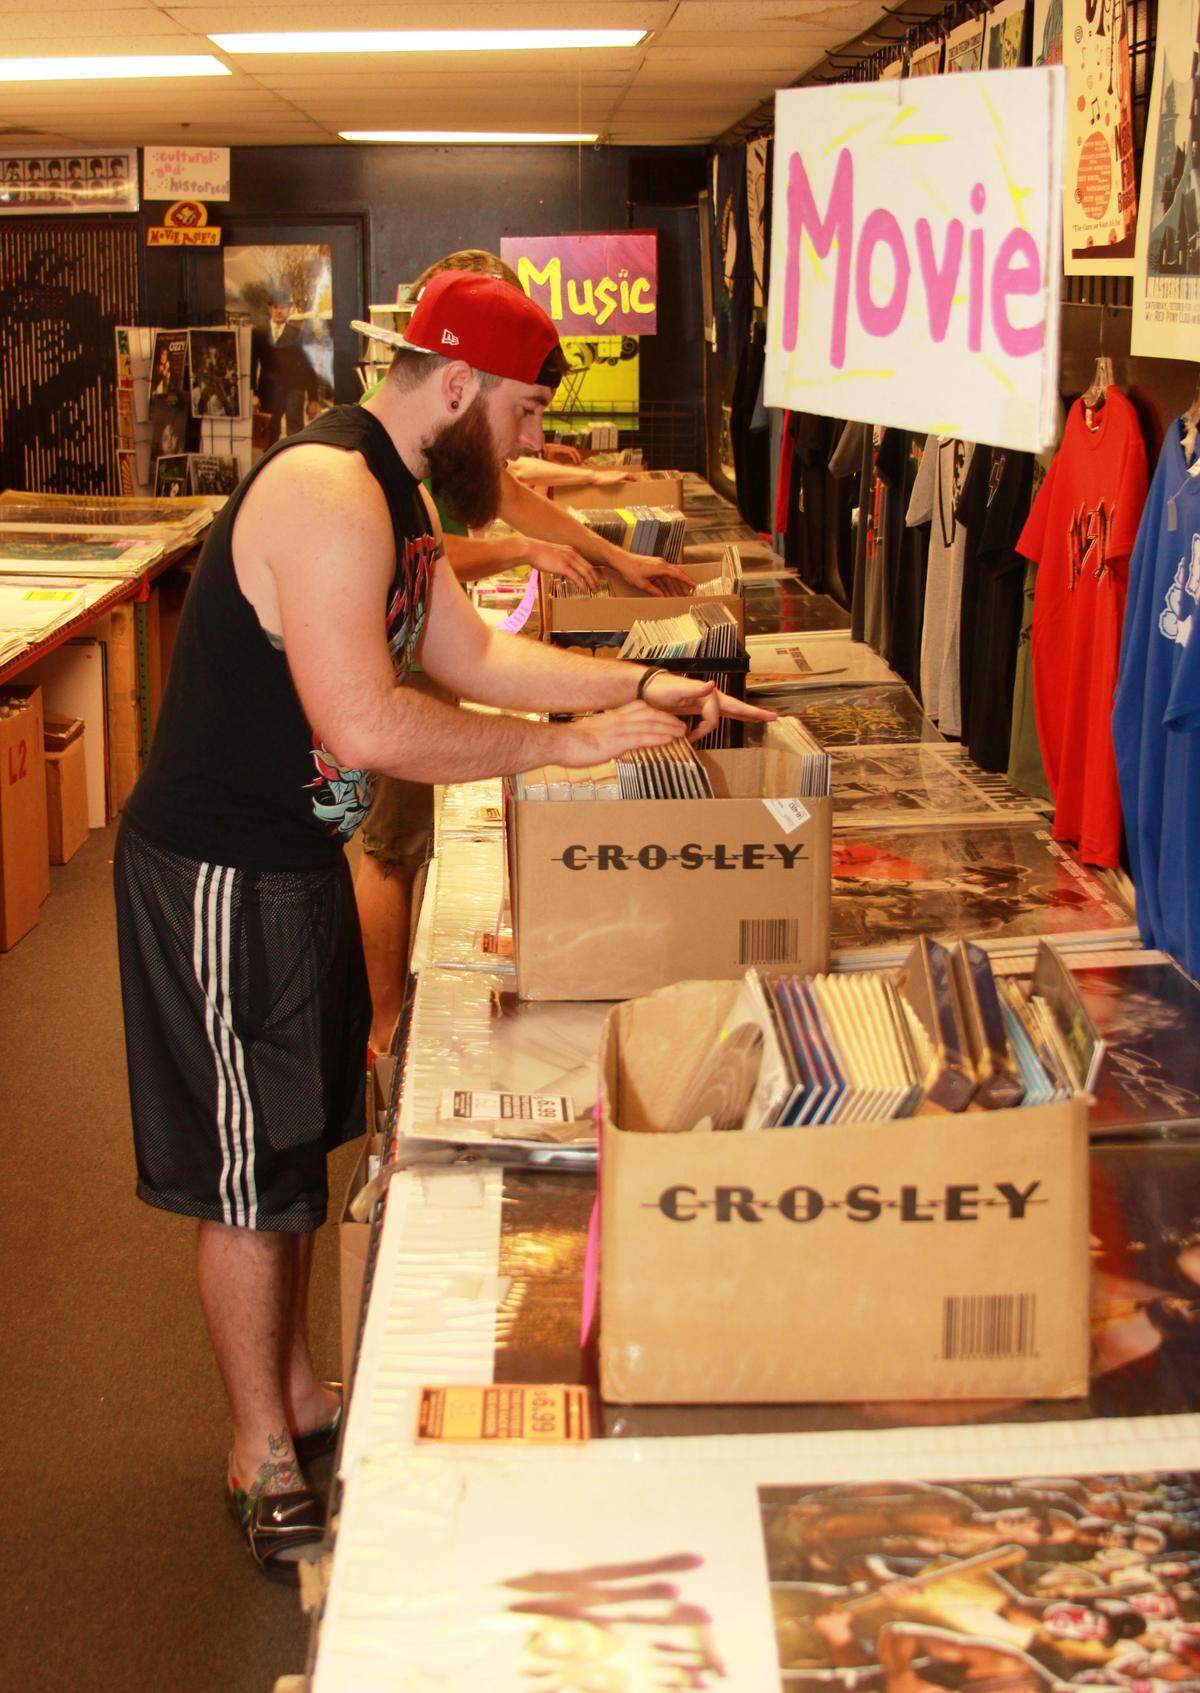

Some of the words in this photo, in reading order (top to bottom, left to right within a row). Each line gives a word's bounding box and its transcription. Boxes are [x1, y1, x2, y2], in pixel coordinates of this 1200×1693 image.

[782, 147, 1045, 370] Movie
[517, 256, 656, 326] Music
[561, 843, 805, 871] CROSLEY
[657, 1179, 1043, 1223] CROSLEY
